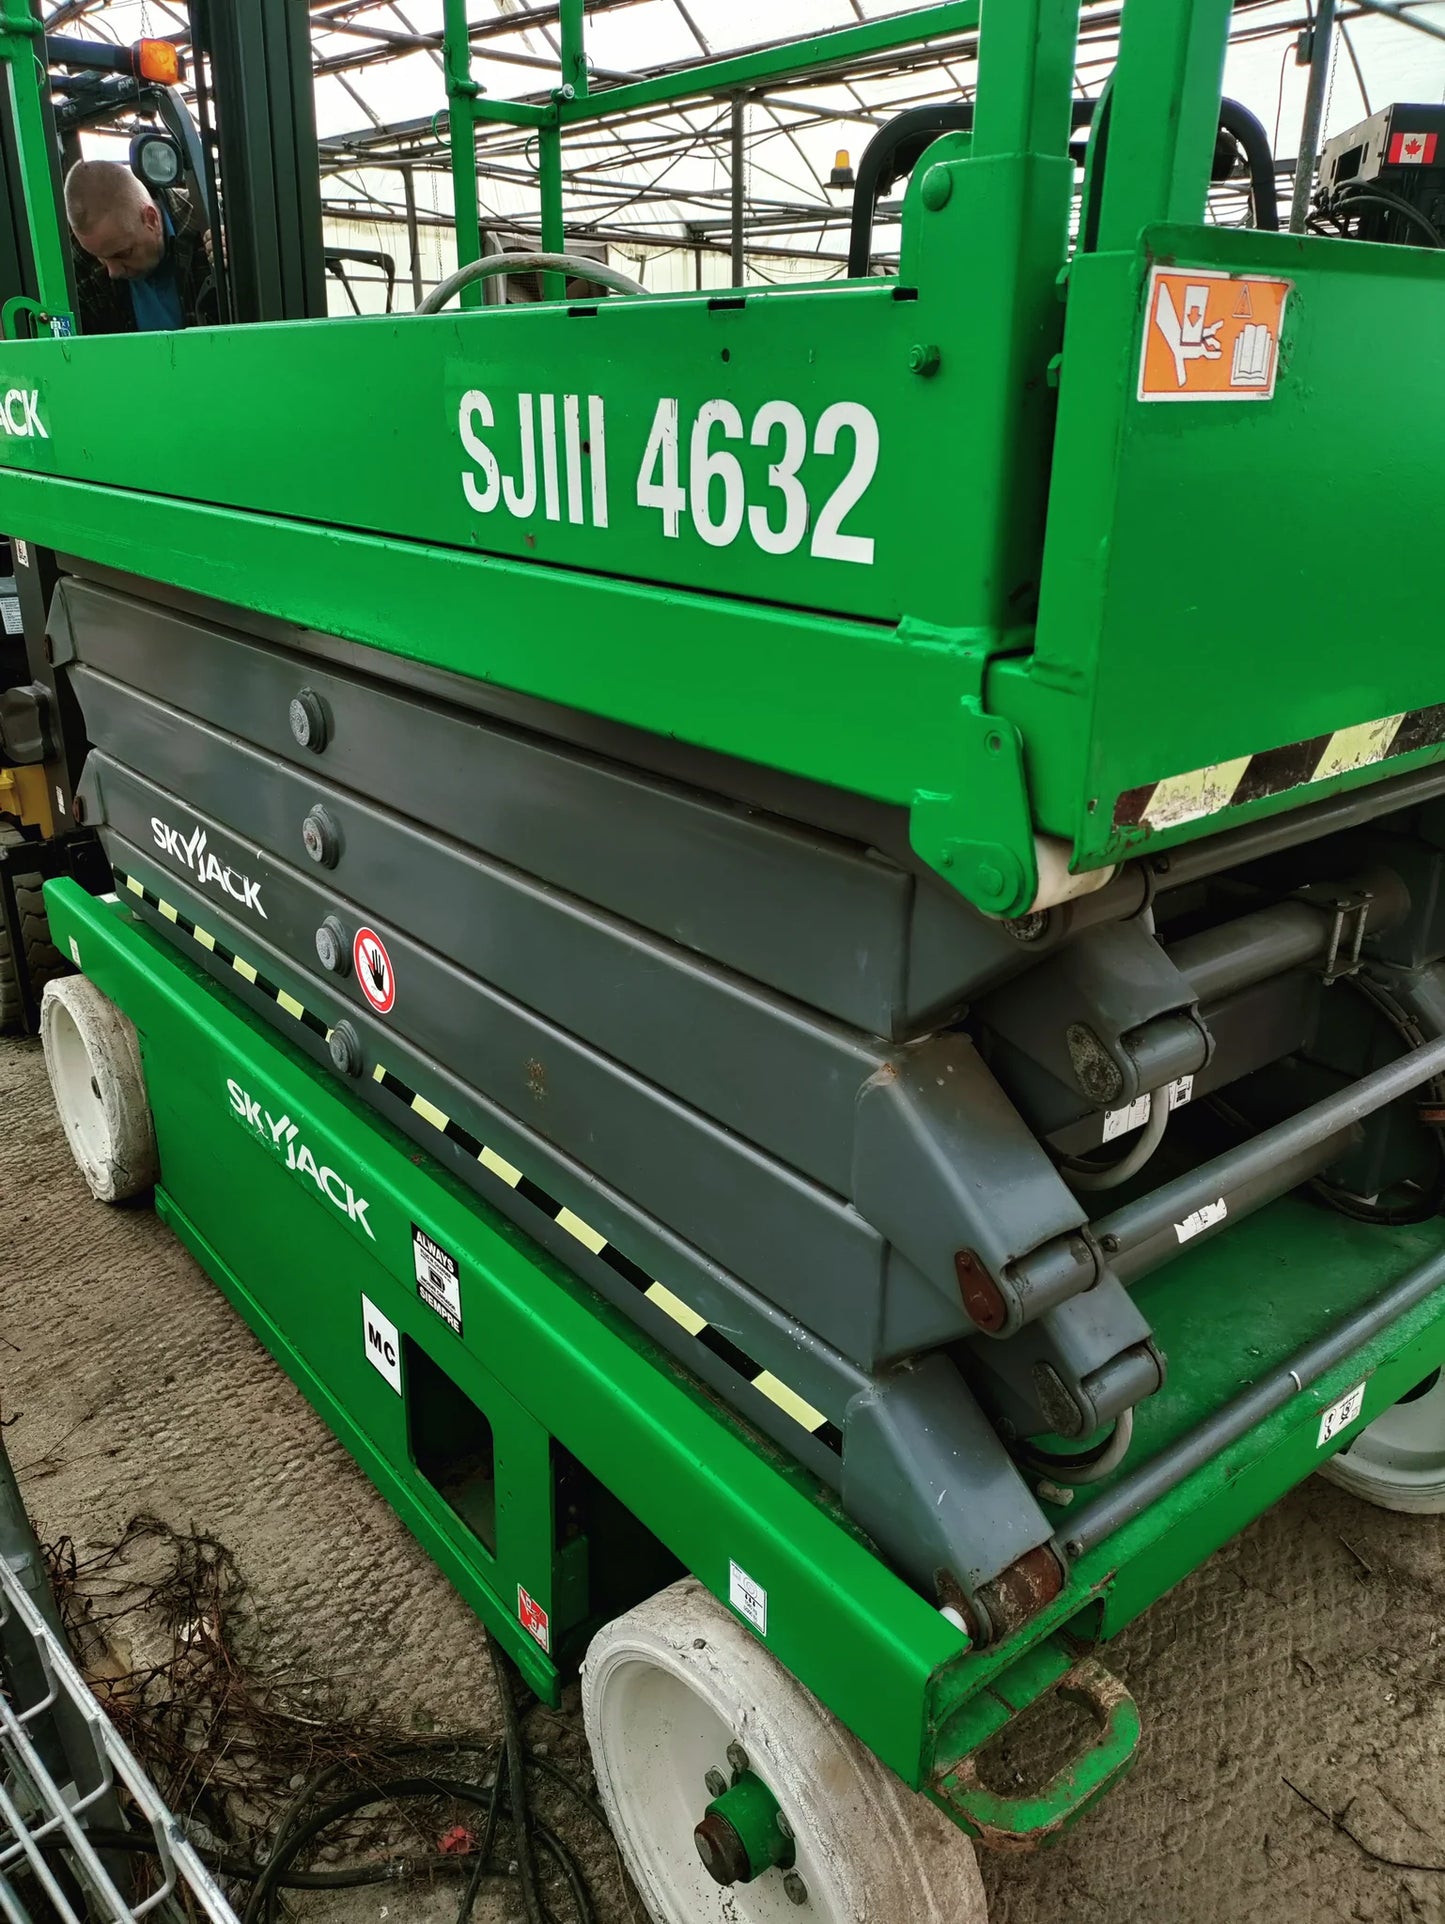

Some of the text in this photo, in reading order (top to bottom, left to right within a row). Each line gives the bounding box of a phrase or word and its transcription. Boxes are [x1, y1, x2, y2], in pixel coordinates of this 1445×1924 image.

[458, 389, 880, 565] SJIII 4632
[416, 1230, 454, 1273] ALWAYS
[420, 1286, 460, 1334] SIEMPRE
[368, 1321, 396, 1368] MC
